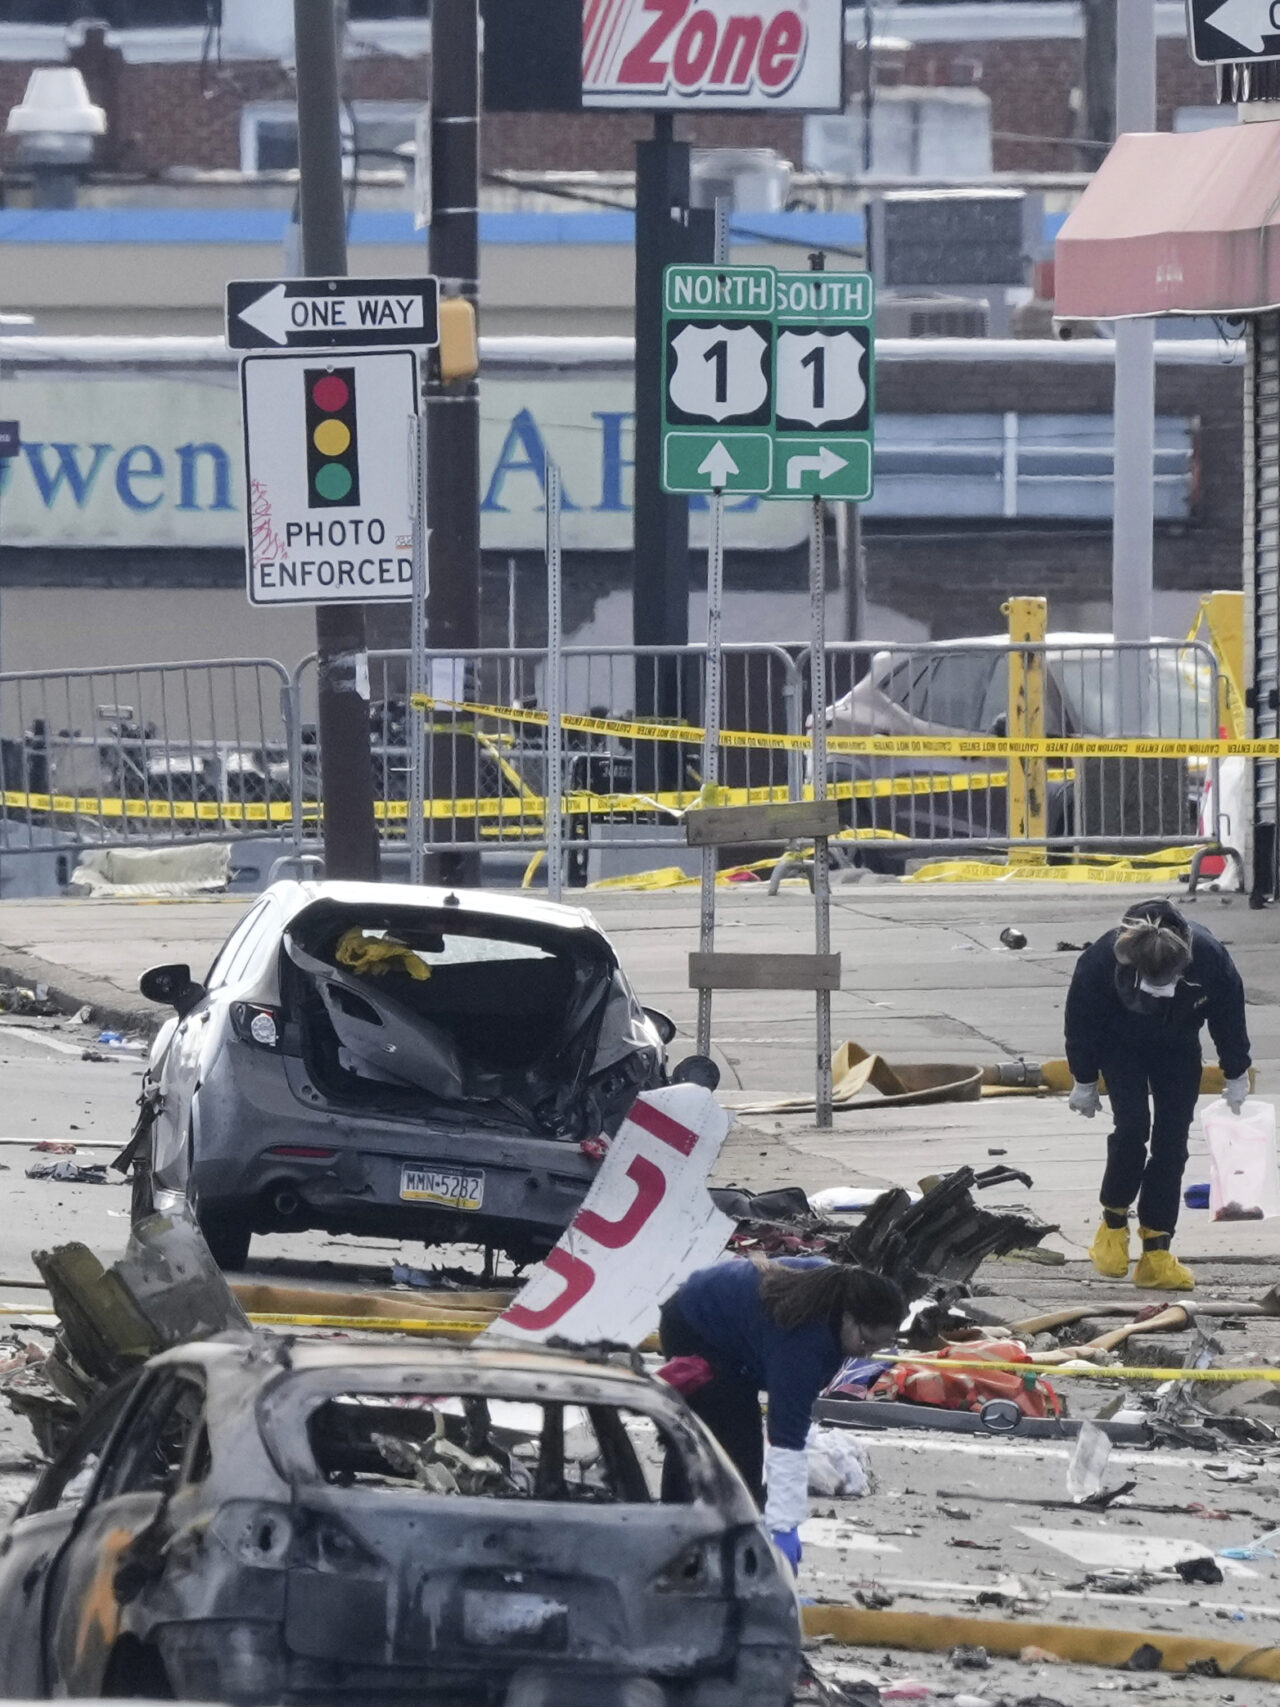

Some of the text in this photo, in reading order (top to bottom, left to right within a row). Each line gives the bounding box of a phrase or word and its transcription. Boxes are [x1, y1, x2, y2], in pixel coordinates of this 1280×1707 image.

[617, 0, 803, 86] Zone
[674, 275, 767, 305] NORTH
[777, 282, 863, 310] SOUTH
[290, 299, 415, 326] ONE WAY
[702, 340, 728, 403] 1
[800, 346, 825, 408] 1
[286, 518, 385, 547] PHOTO
[260, 558, 413, 587] ENFORCED
[1045, 743, 1128, 753] CAUTION DO NOT ENTER
[1176, 744, 1186, 753] DO
[1227, 744, 1250, 753] ENTER
[1252, 744, 1267, 753] NOT
[1268, 744, 1279, 753] DO
